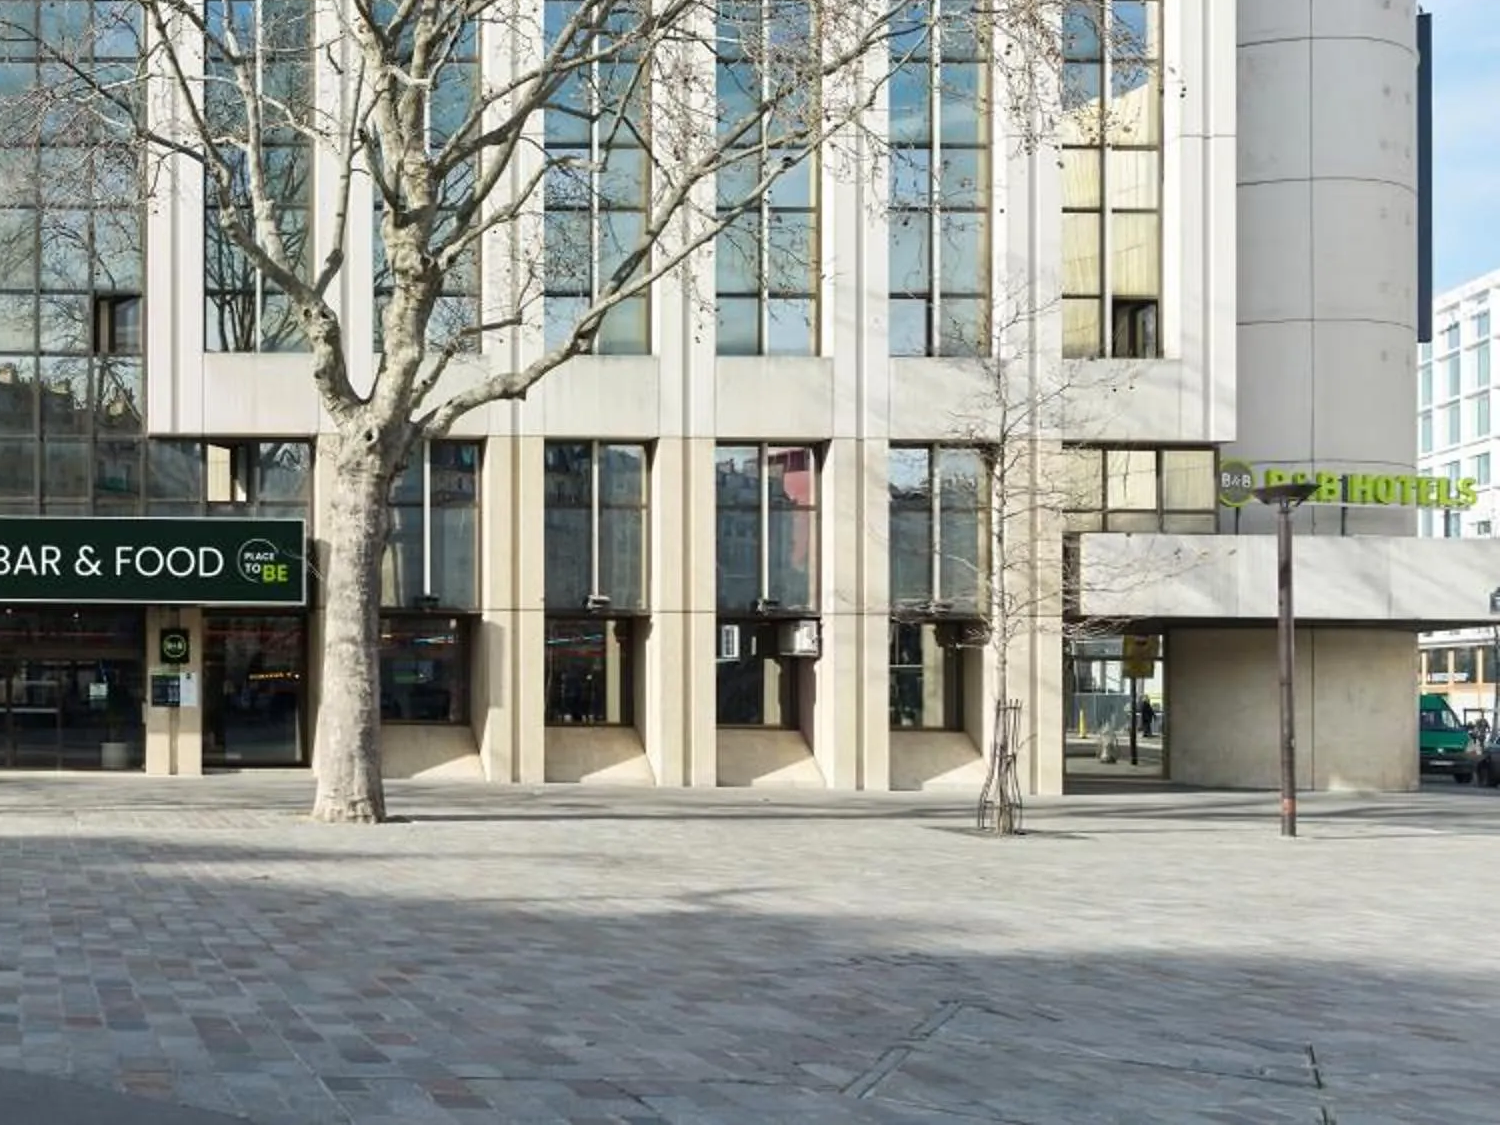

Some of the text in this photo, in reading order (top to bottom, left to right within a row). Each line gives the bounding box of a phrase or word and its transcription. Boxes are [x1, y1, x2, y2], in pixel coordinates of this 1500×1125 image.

[1347, 473, 1478, 507] HOTELS
[75, 545, 102, 576] &
[115, 546, 224, 576] FOOD
[244, 552, 275, 561] PLACE
[244, 562, 289, 582] TO BE
